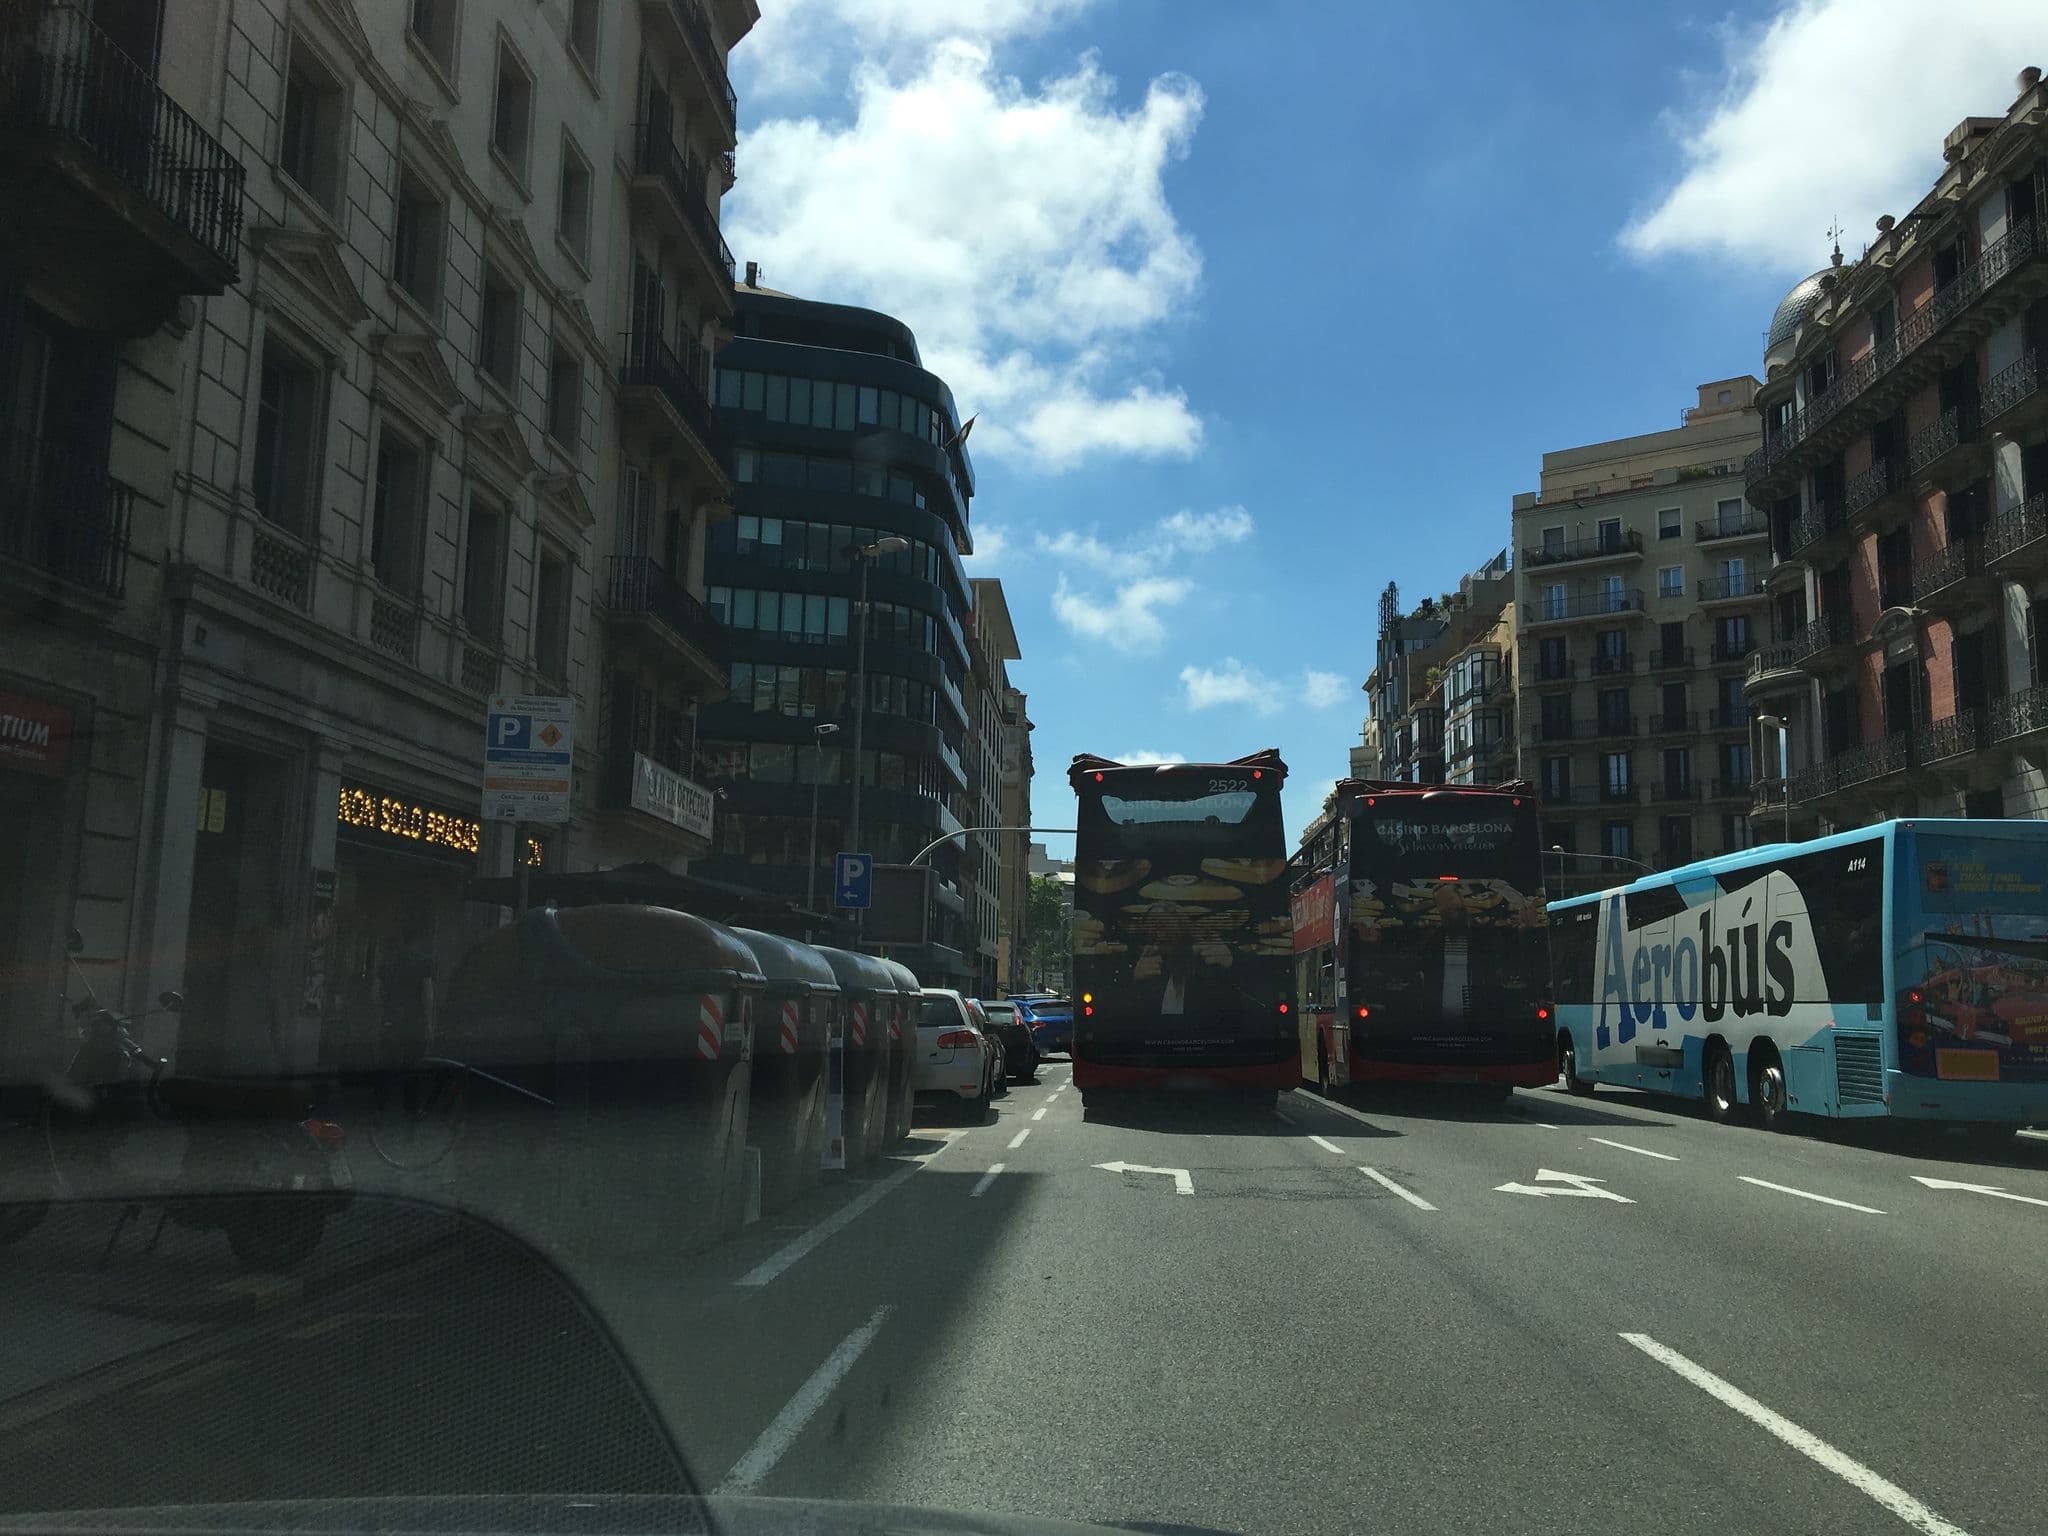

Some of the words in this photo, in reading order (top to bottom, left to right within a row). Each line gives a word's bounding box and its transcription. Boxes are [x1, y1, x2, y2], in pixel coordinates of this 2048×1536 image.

[0, 714, 49, 746] TIUM
[498, 717, 521, 745] P
[1208, 779, 1248, 793] 2522
[338, 787, 377, 828] NON
[380, 796, 422, 840] SOLO
[425, 810, 480, 854] BRASAS
[1376, 823, 1428, 835] CASINO
[1431, 822, 1513, 834] BARCELONA
[843, 858, 865, 886] P
[1847, 857, 1867, 873] A114
[1596, 894, 1795, 1050] Aerobús
